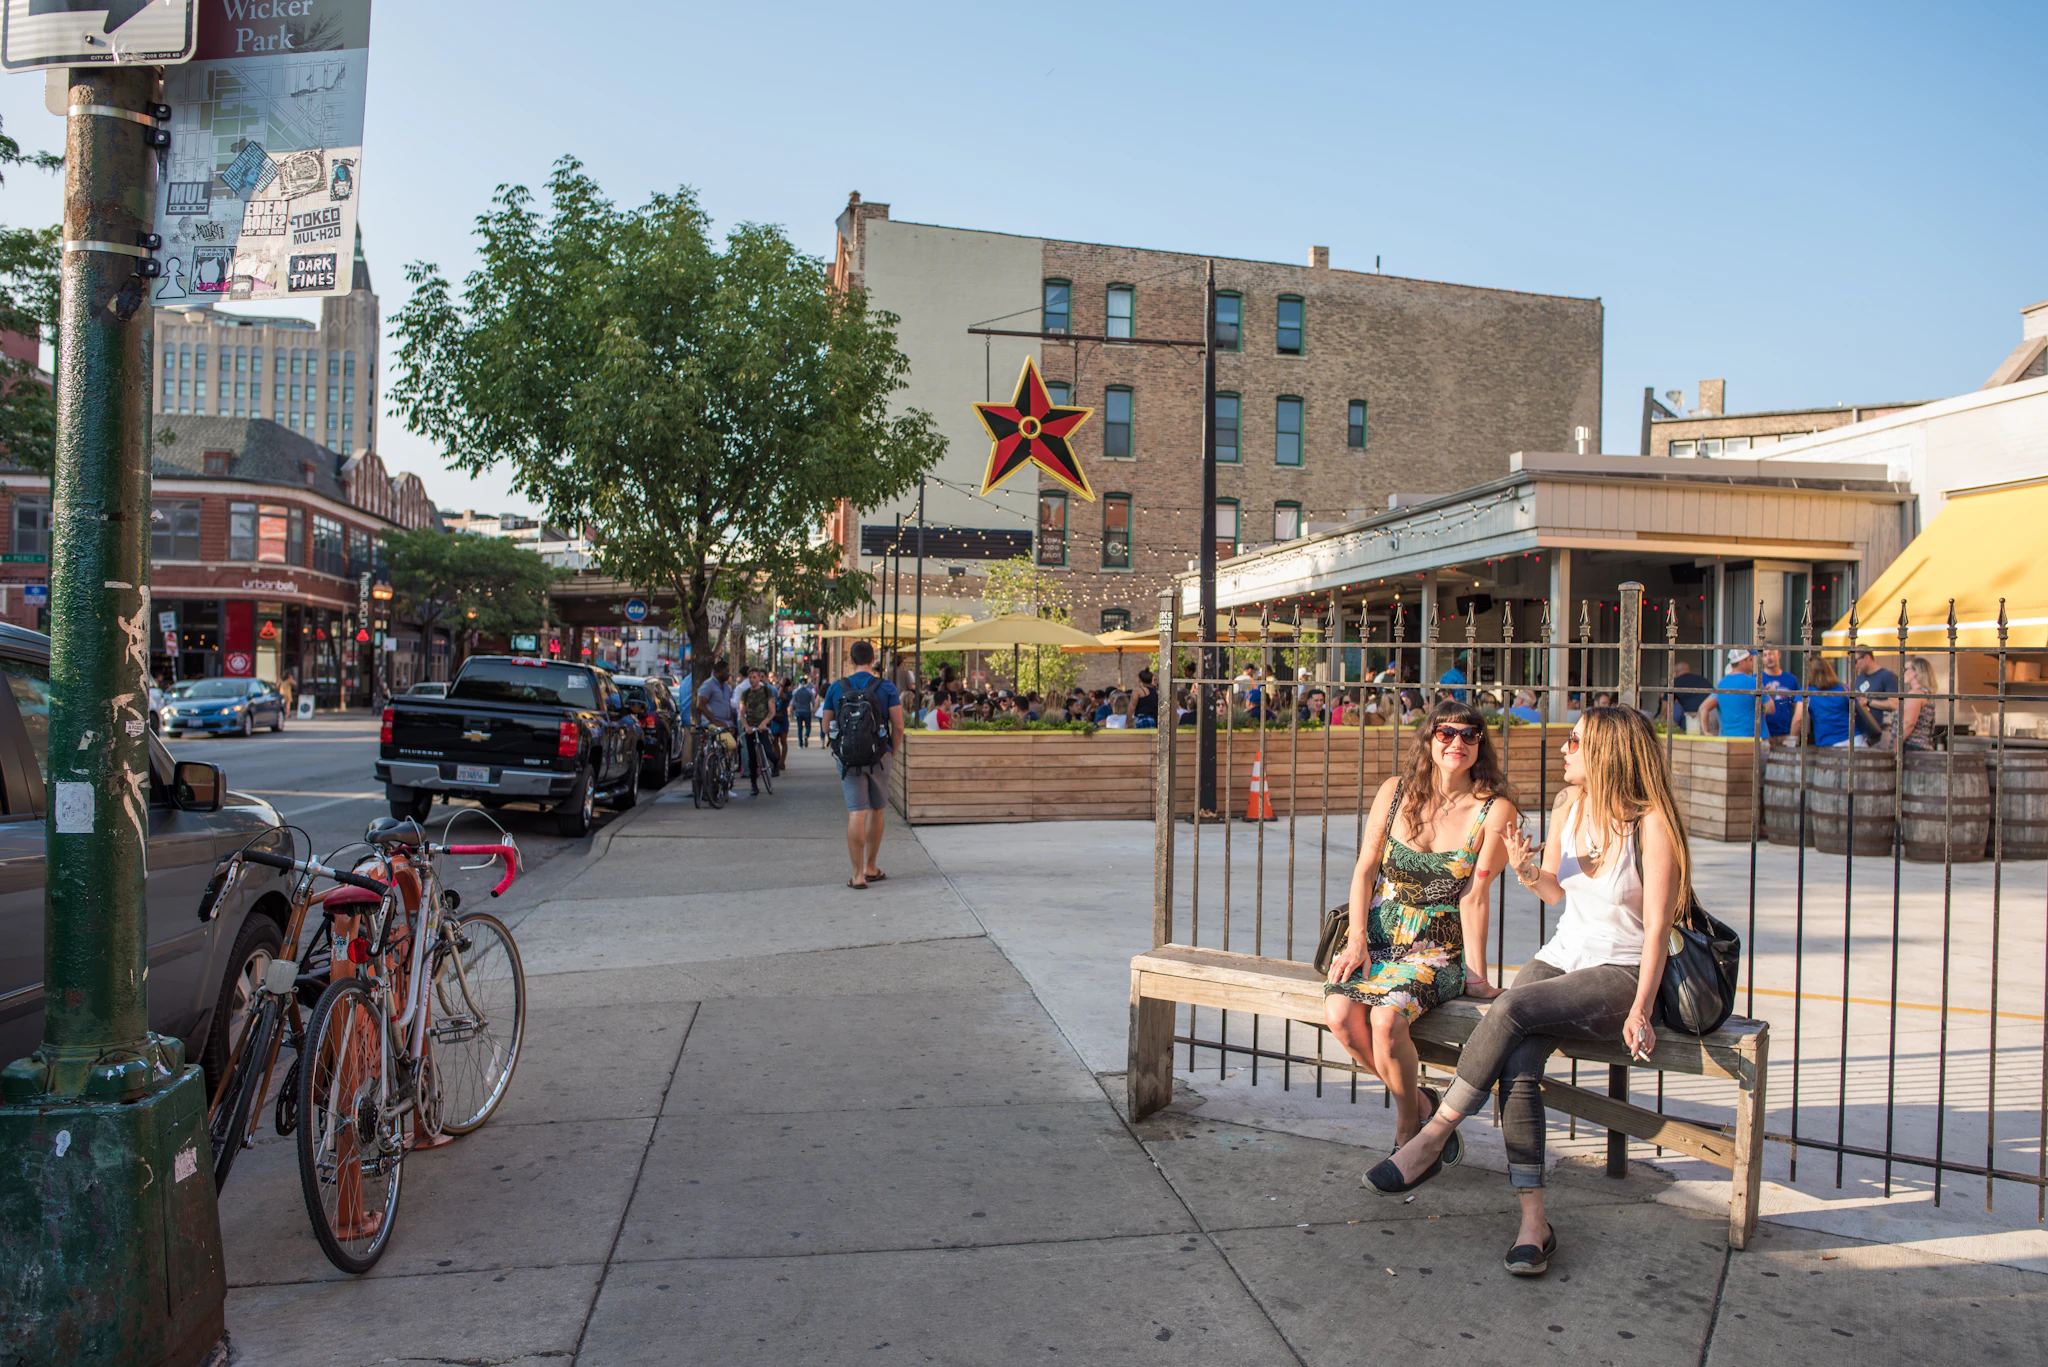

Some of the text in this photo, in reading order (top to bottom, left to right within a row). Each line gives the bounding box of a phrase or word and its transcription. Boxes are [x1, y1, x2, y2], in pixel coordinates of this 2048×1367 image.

[223, 0, 314, 21] Wicker
[235, 24, 295, 53] Park
[169, 183, 209, 204] MUL
[244, 201, 288, 215] EDEM
[297, 257, 332, 271] DARK
[290, 272, 334, 288] TIMES
[242, 579, 298, 593] urbanbelly
[359, 571, 372, 628] urbanbelly
[628, 606, 645, 614] cta
